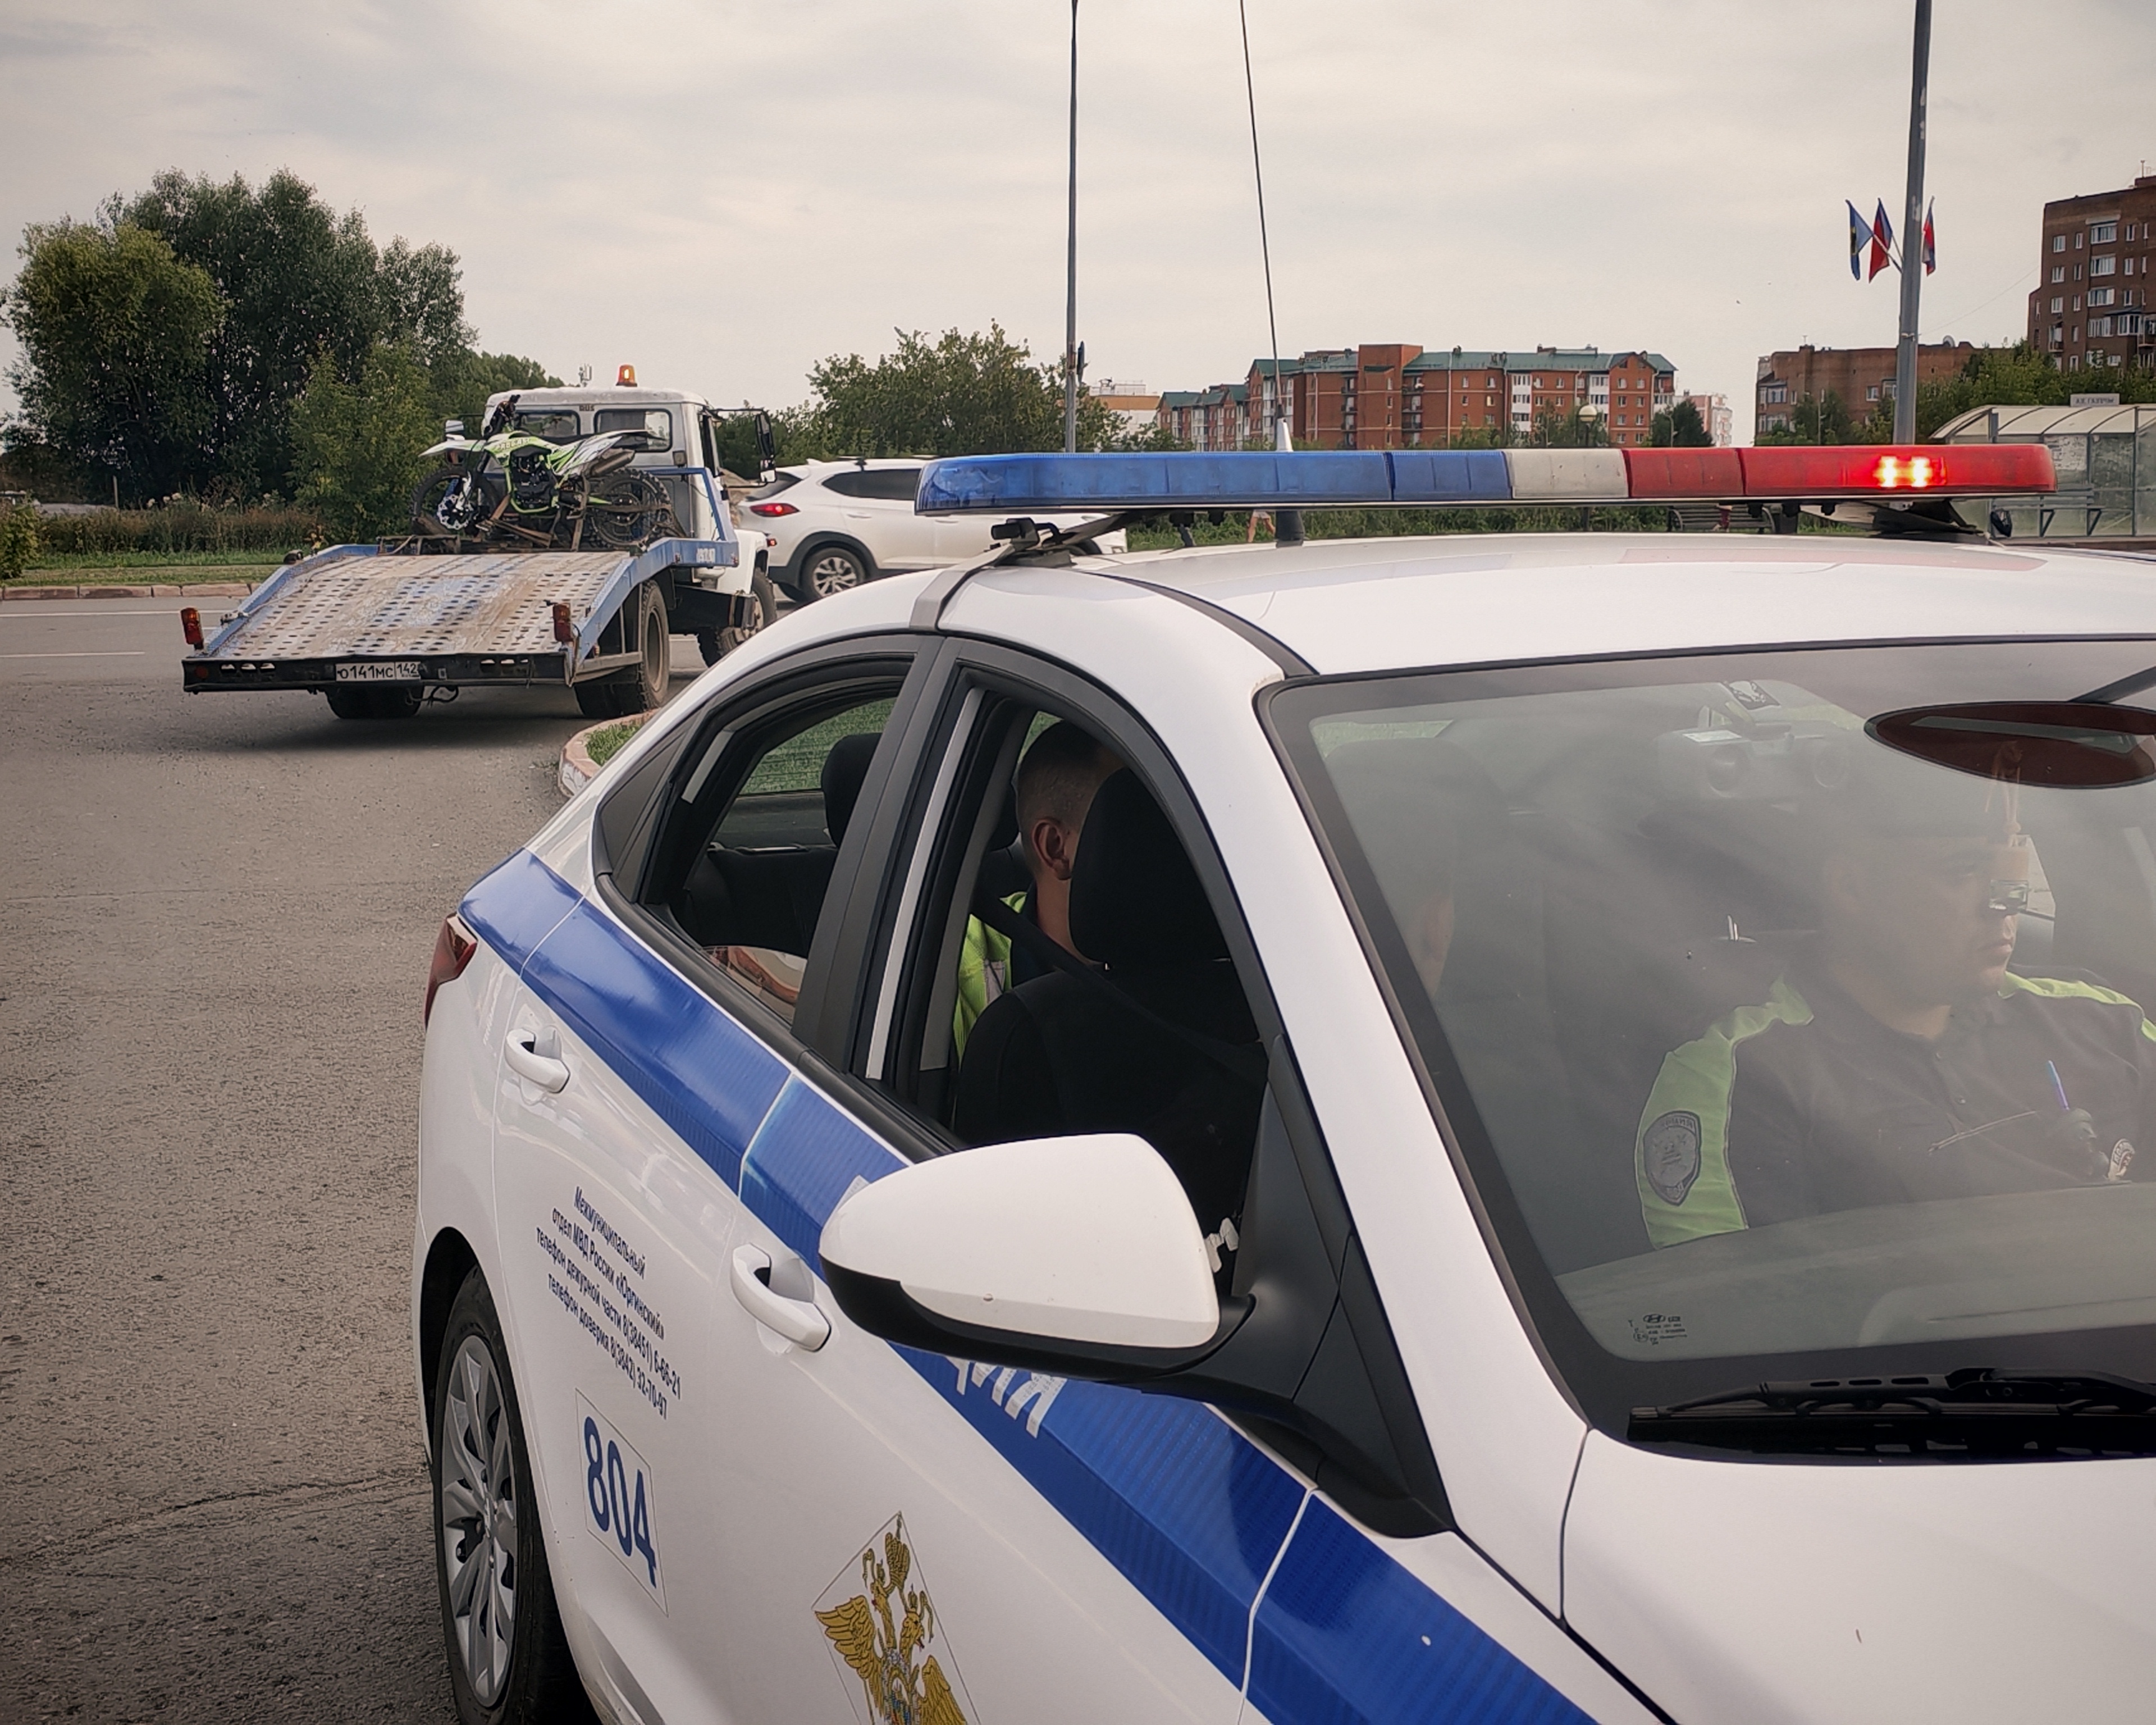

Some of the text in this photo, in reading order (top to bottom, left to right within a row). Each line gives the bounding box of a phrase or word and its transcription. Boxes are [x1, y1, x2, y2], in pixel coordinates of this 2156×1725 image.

[536, 1227, 566, 1270] телефон
[566, 1259, 600, 1307] дежурной
[601, 1295, 622, 1331] части
[623, 1314, 653, 1372] 8(38451)
[552, 1208, 572, 1240] отдел
[573, 1223, 589, 1262] МВД
[589, 1240, 614, 1286] России
[548, 1274, 579, 1318] телефон
[579, 1307, 610, 1352] доверия
[610, 1336, 636, 1389] 8(3842)
[584, 1417, 656, 1589] 804
